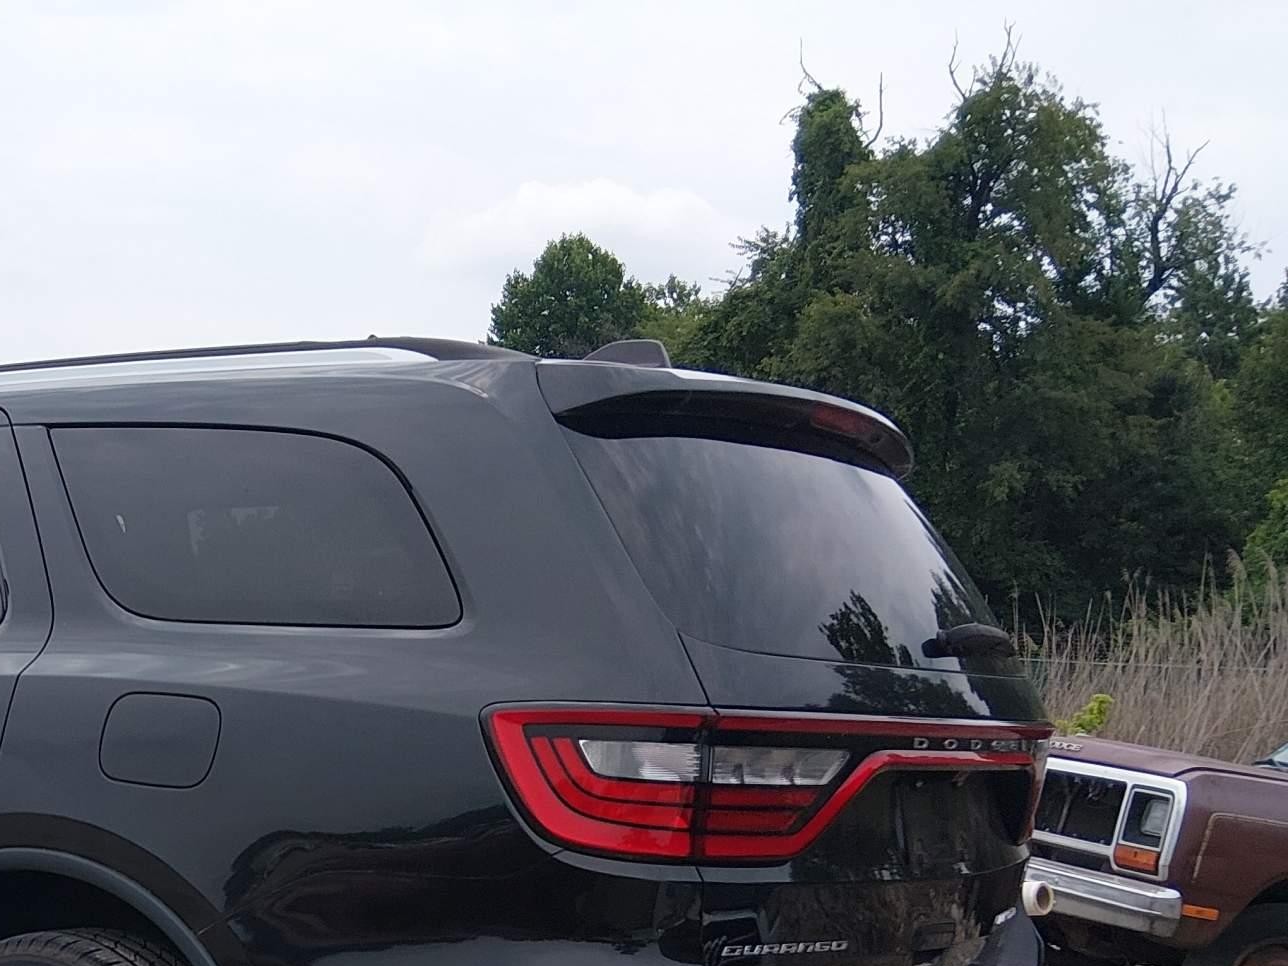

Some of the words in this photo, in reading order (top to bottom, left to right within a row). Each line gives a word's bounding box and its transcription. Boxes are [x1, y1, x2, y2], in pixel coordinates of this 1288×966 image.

[913, 737, 1020, 751] DODGE
[1049, 740, 1083, 752] ODGE
[721, 940, 849, 957] DURANGO
